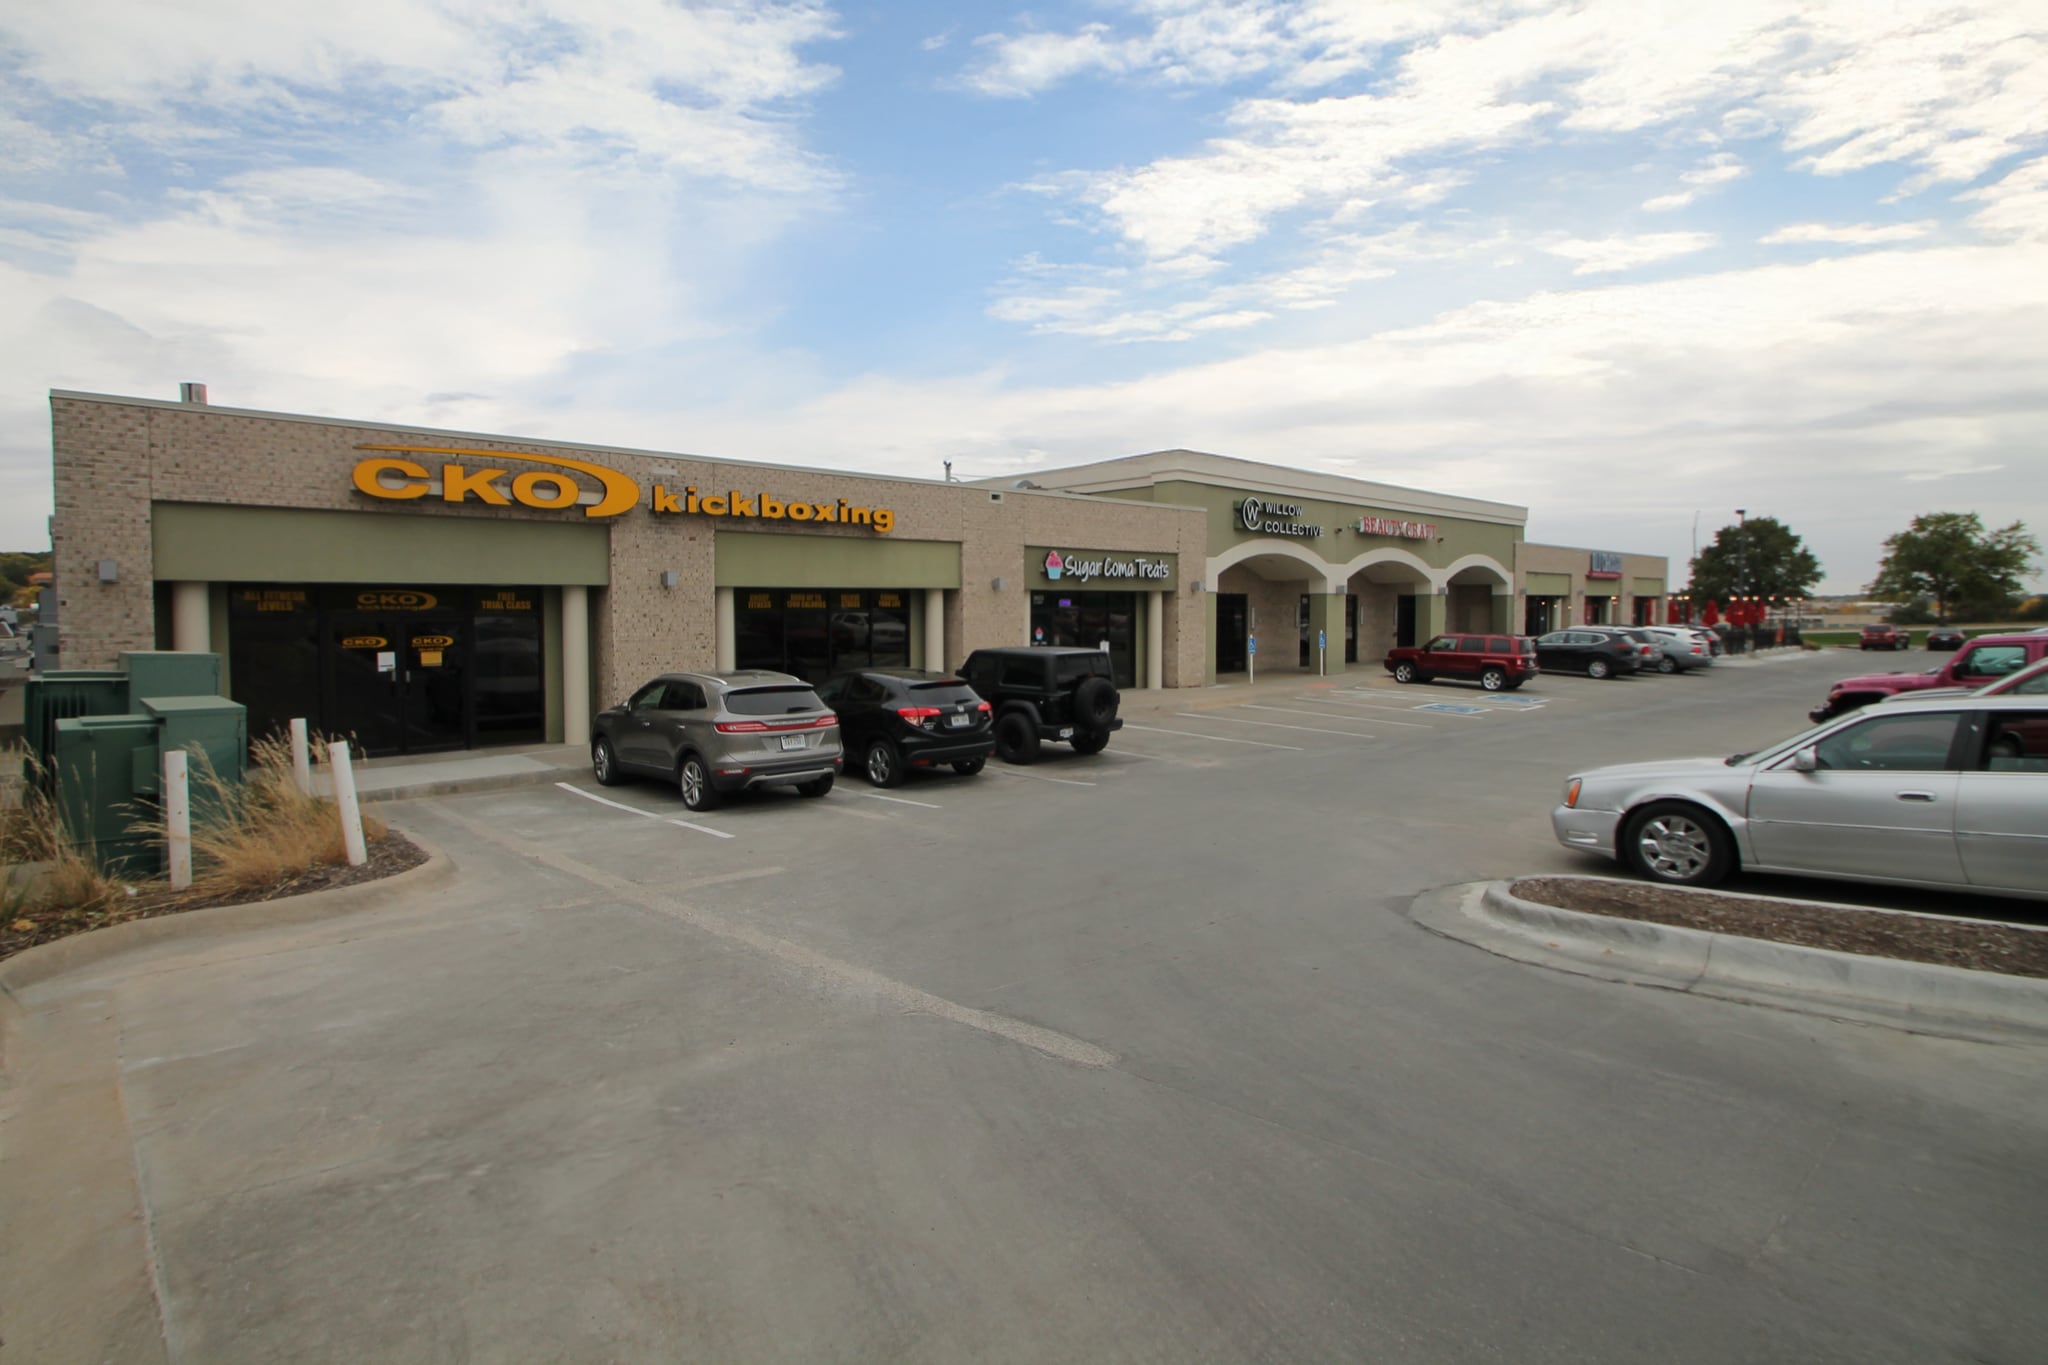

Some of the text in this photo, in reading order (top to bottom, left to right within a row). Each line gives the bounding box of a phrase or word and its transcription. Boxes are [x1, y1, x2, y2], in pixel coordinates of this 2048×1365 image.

[352, 457, 895, 533] CKO kickboxing
[1265, 502, 1303, 516] WILLOW
[1265, 521, 1325, 536] COLLECTIVE
[1361, 516, 1402, 537] BEAUTY
[1064, 555, 1169, 582] Sugar Coma Treats
[357, 593, 420, 605] CKO
